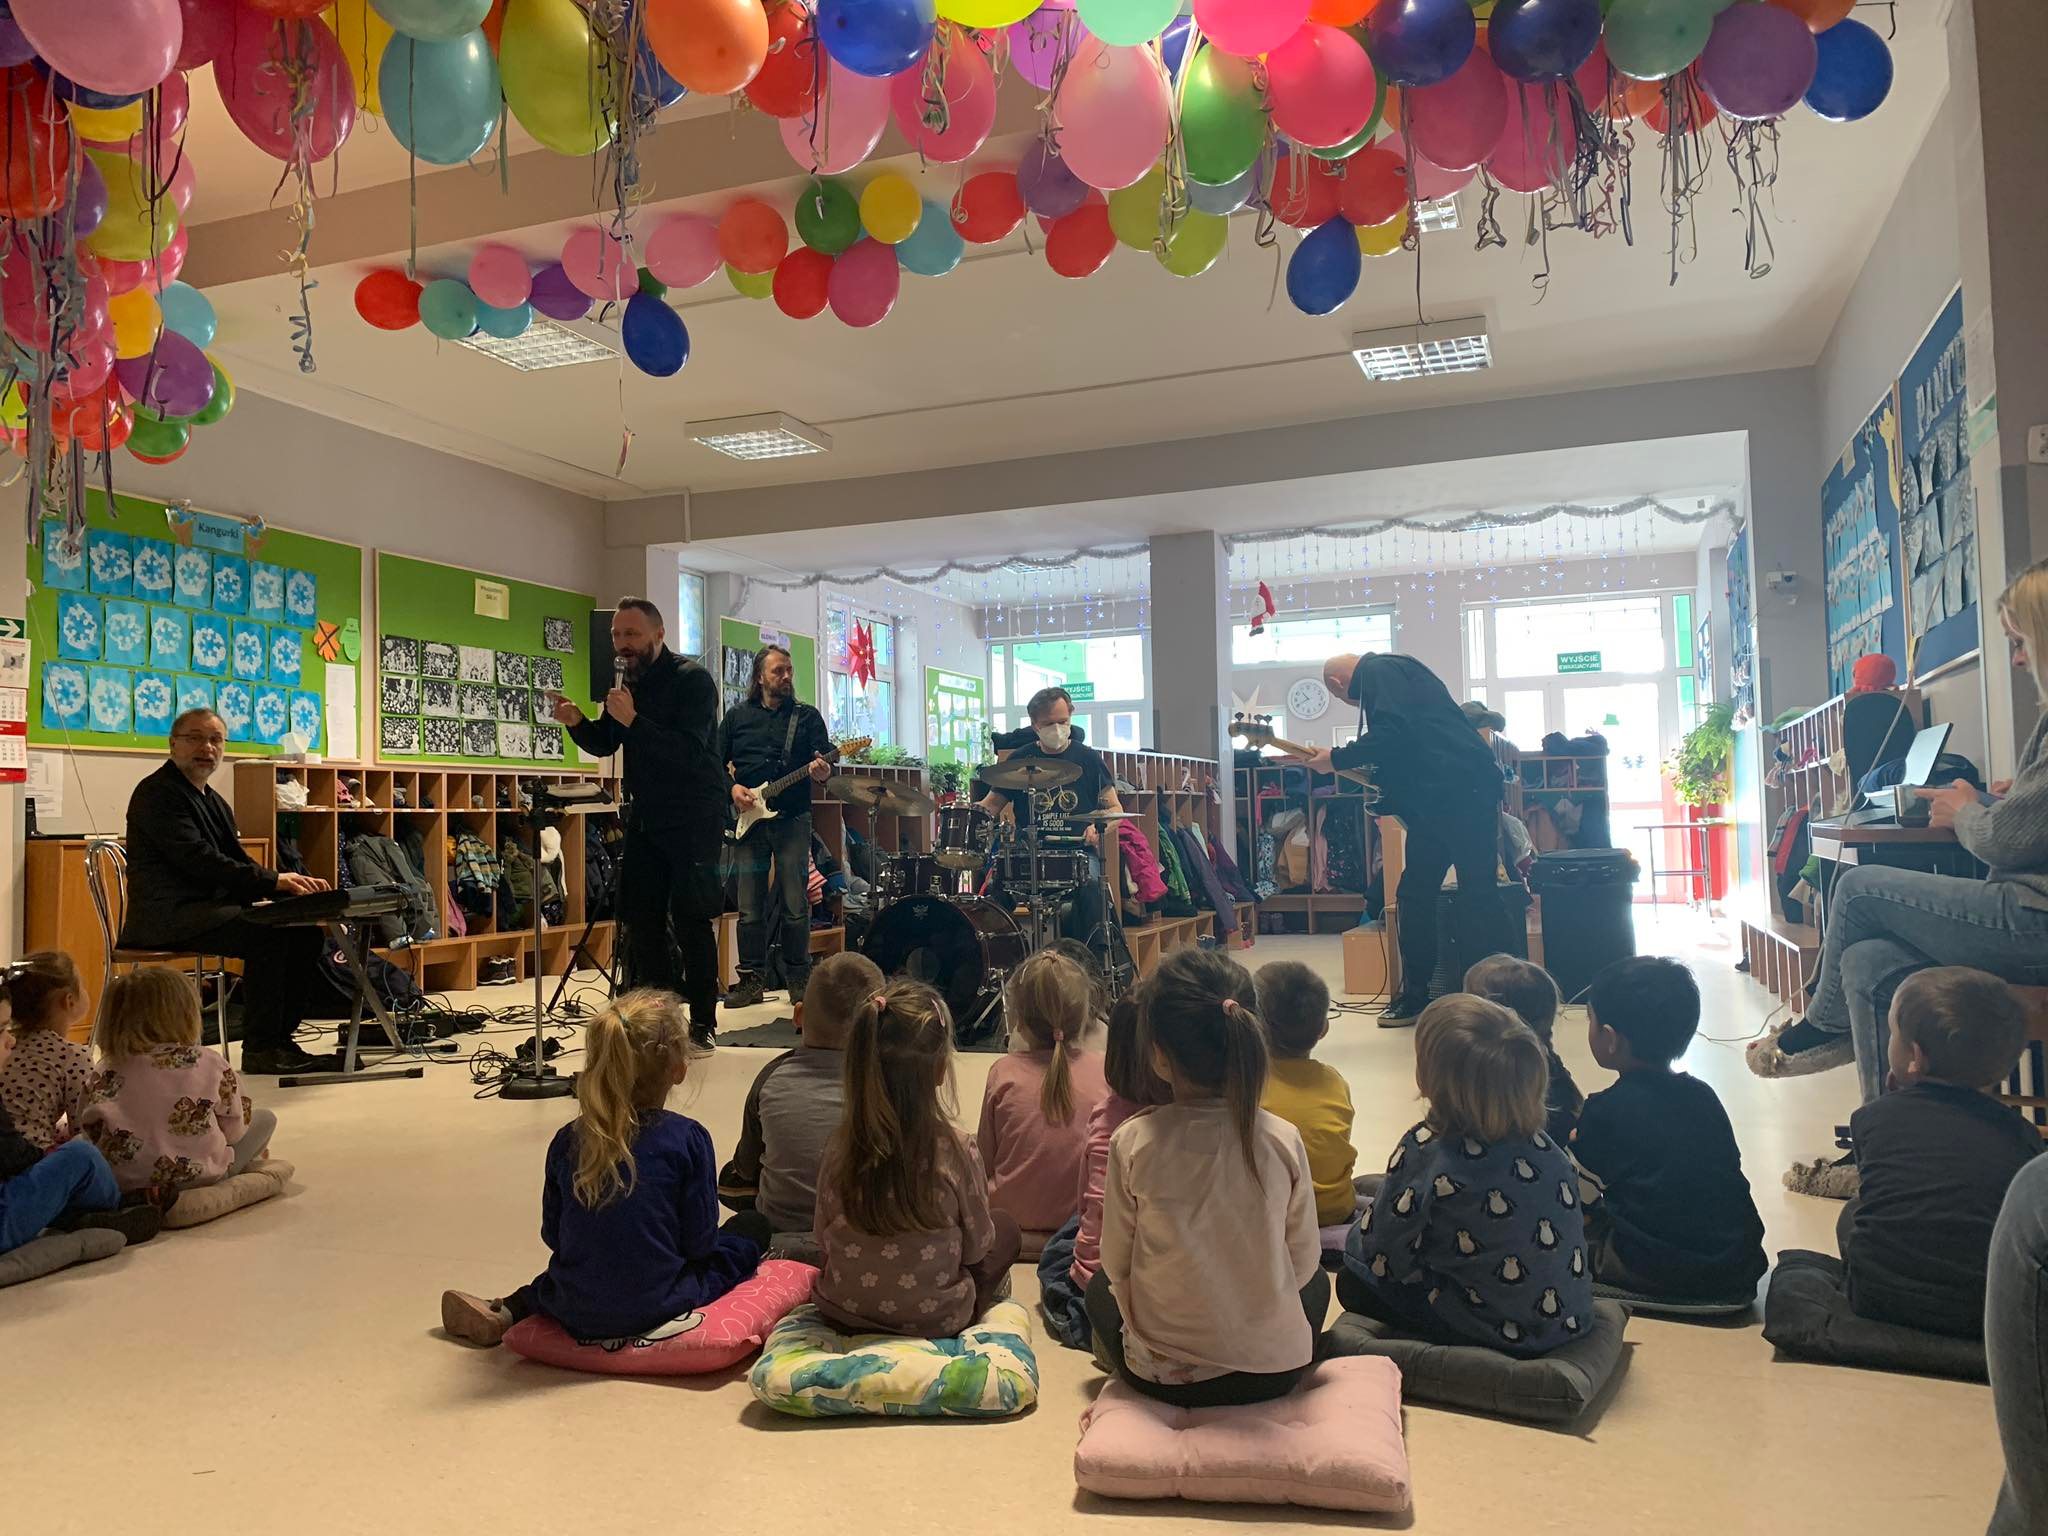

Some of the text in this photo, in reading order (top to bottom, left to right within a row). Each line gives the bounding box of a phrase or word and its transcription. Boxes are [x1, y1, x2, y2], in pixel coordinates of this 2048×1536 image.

[198, 522, 239, 539] Kangurki
[1560, 654, 1598, 663] WYJŚCIE
[1042, 812, 1058, 821] SIMPLE
